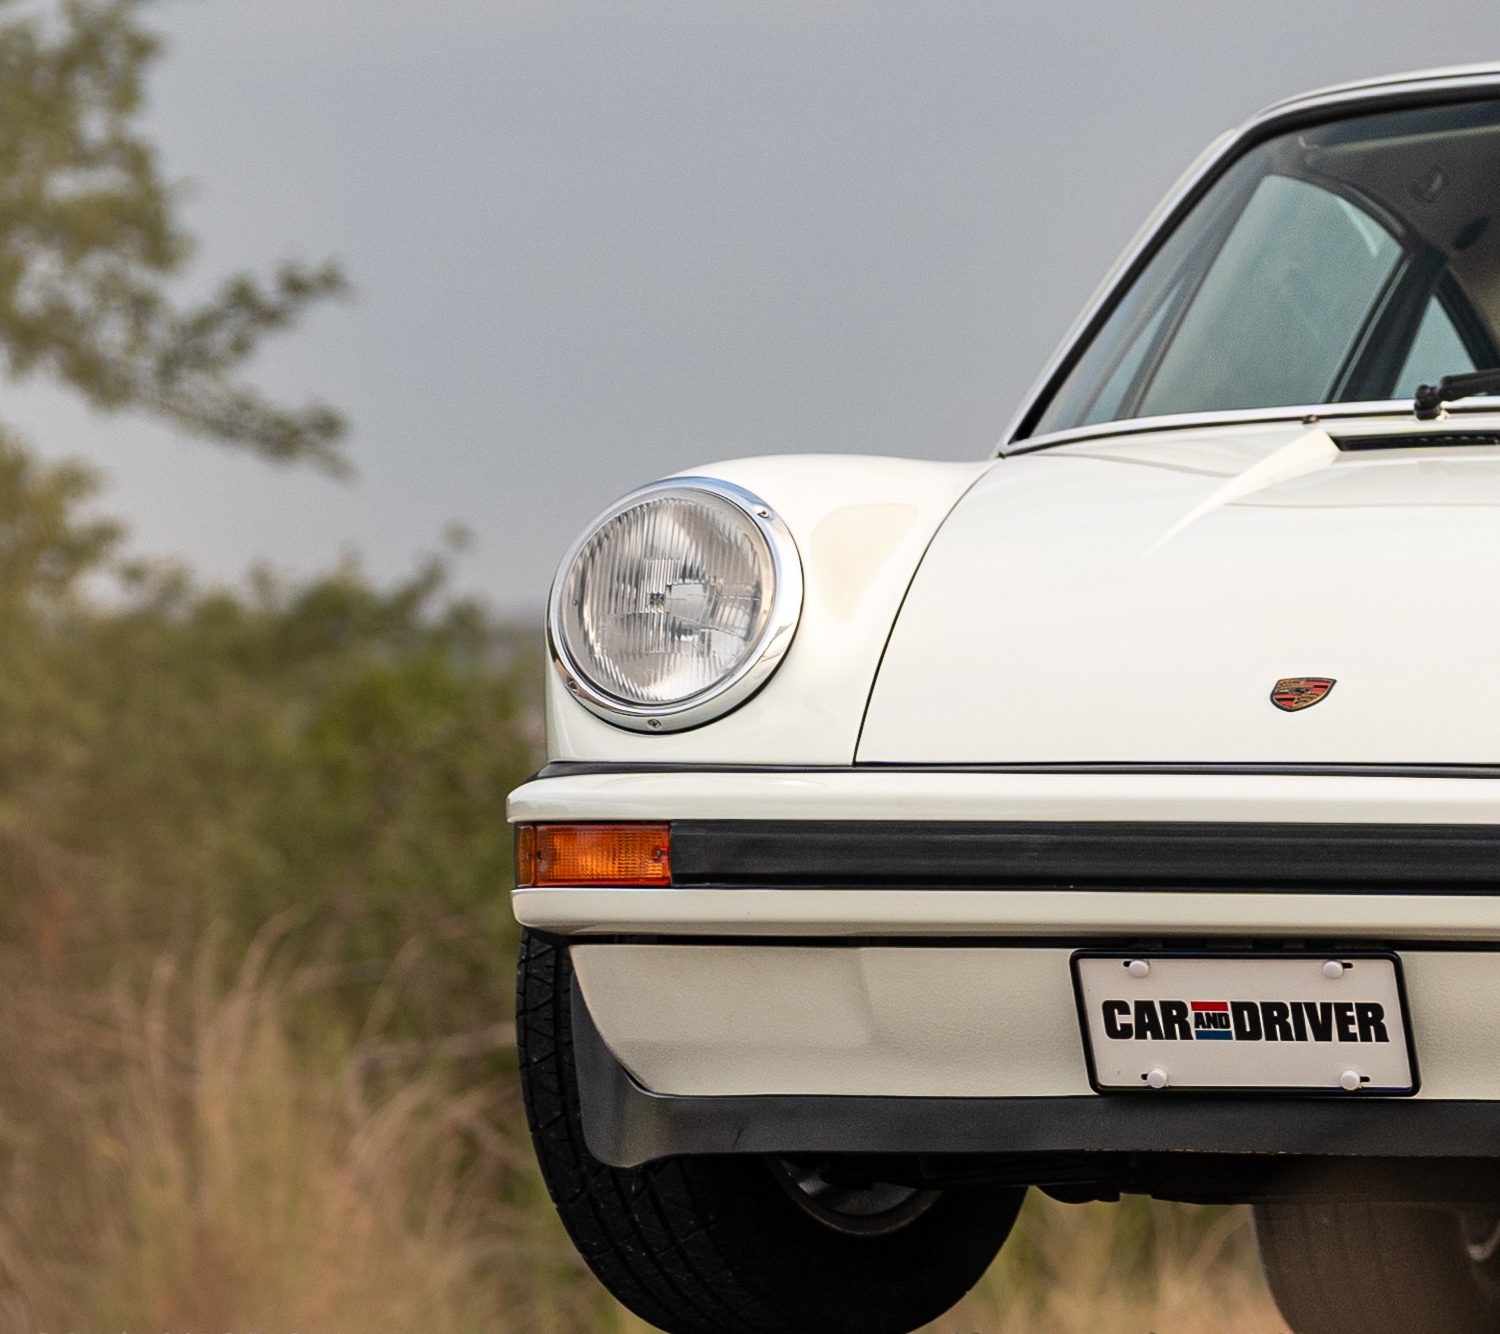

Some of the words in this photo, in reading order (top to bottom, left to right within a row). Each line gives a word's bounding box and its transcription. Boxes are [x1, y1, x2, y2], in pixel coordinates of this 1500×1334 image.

[1101, 999, 1193, 1040] CAR
[1194, 1012, 1231, 1030] AND
[1230, 1001, 1389, 1042] DRIVER
